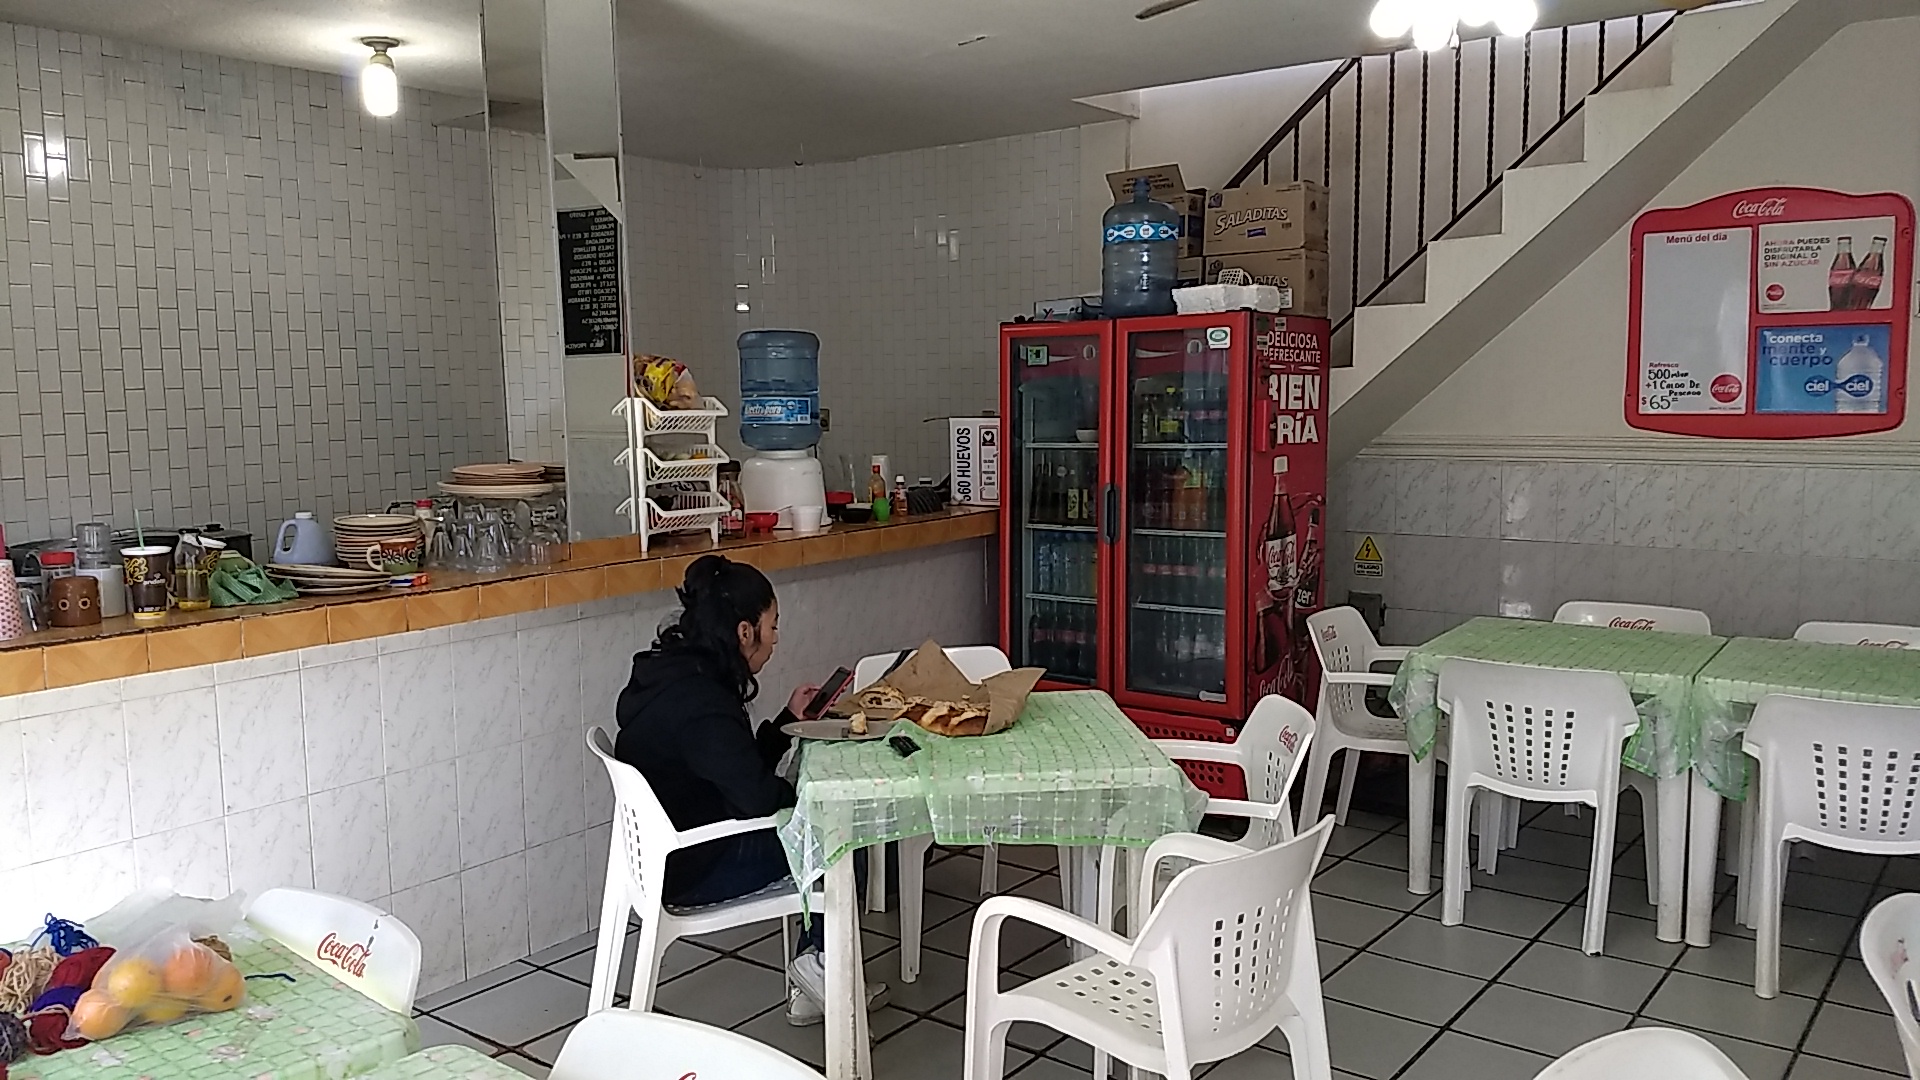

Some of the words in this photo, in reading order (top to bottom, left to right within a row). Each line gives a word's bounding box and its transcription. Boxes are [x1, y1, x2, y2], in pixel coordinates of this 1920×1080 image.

[1213, 206, 1289, 236] SALADITAS
[1666, 234, 1693, 244] Menú
[1694, 233, 1710, 242] del
[1796, 237, 1831, 245] PUEDES
[1253, 275, 1289, 288] DITAS
[1267, 330, 1319, 350] DELICIOSA
[1762, 344, 1816, 355] mente
[1819, 346, 1827, 356] y
[1769, 355, 1833, 368] cuerpo
[1805, 379, 1829, 392] ciel
[1845, 379, 1870, 392] ciel
[1269, 411, 1319, 444] RÍA
[956, 427, 971, 478] HUEVOS
